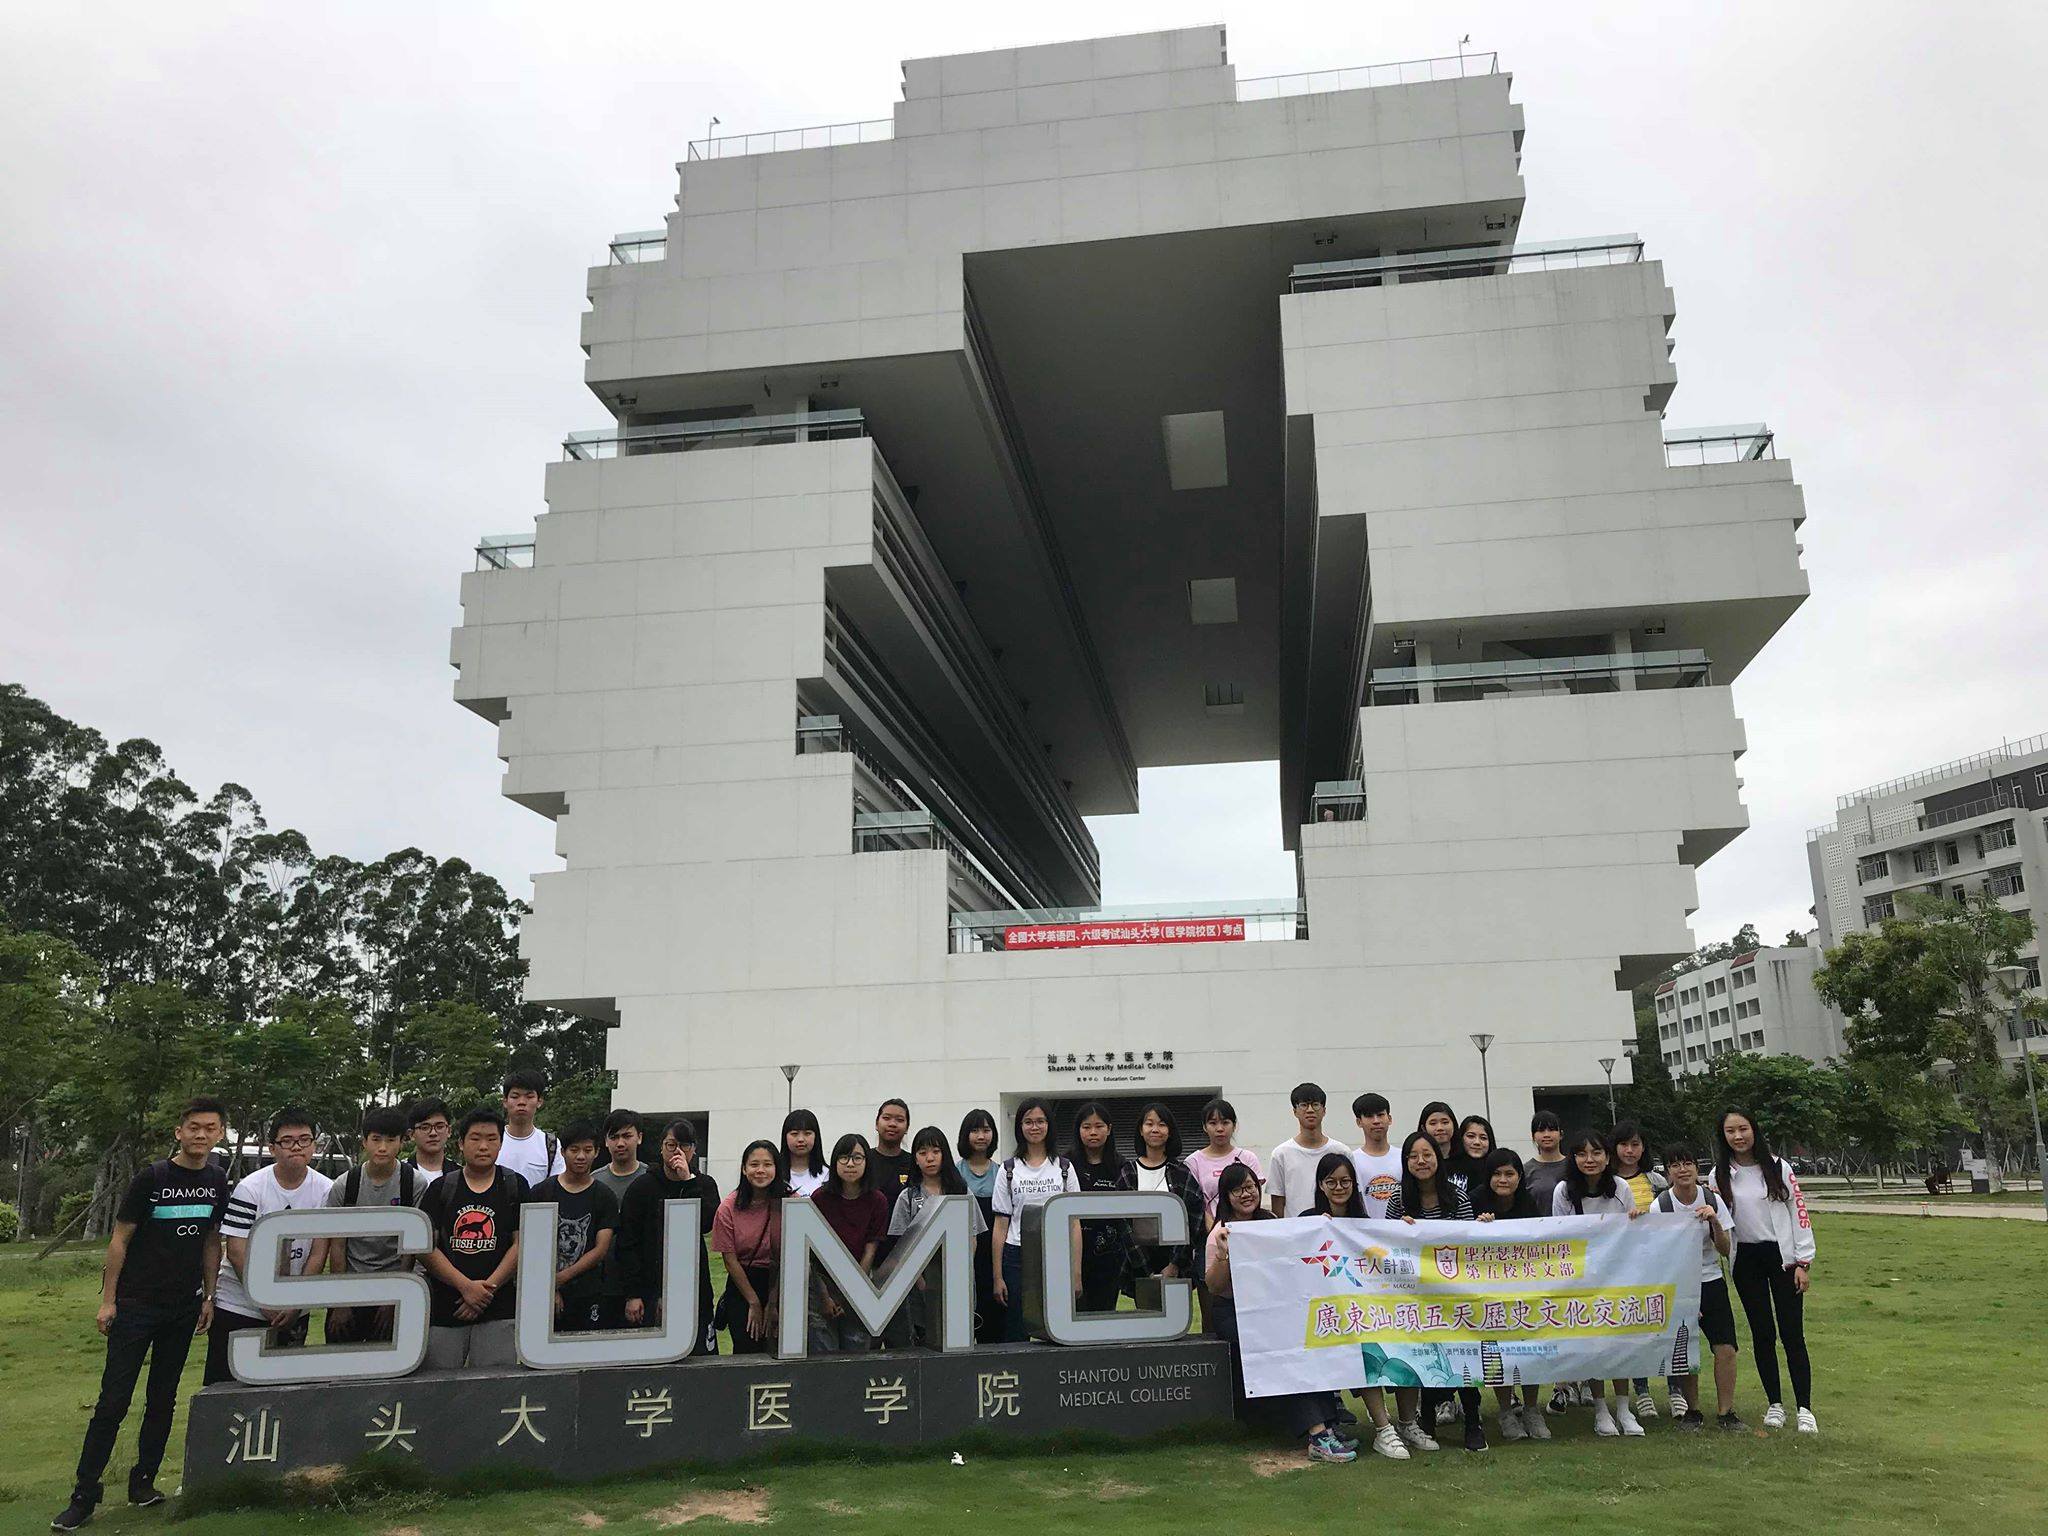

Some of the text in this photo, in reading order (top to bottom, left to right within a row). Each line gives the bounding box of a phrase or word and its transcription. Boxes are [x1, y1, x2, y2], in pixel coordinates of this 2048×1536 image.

[1047, 1050, 1174, 1064] 汕头大学医学院
[1080, 1063, 1114, 1072] University
[1117, 1062, 1144, 1070] Medical
[1147, 1062, 1174, 1070] College
[1013, 1185, 1062, 1195] SATISFACTION
[1020, 1178, 1054, 1187] MINIMUM
[162, 1187, 217, 1199] DIAMOND
[1789, 1172, 1811, 1229] adidas
[177, 1225, 199, 1236] CO.
[1465, 1243, 1571, 1262] 聖若瑟教區中學
[1354, 1257, 1415, 1275] 千人計劃
[1465, 1261, 1575, 1280] 第五校英文部
[227, 1191, 1193, 1385] SUMC
[1314, 1293, 1667, 1337] 廣東汕頭五天歷史文化交流團
[1058, 1362, 1218, 1385] SHANTOU UNIVERSITY
[1059, 1386, 1192, 1408] MEDICAL COLLEGE
[226, 1370, 1020, 1464] 汕头大学医学院
